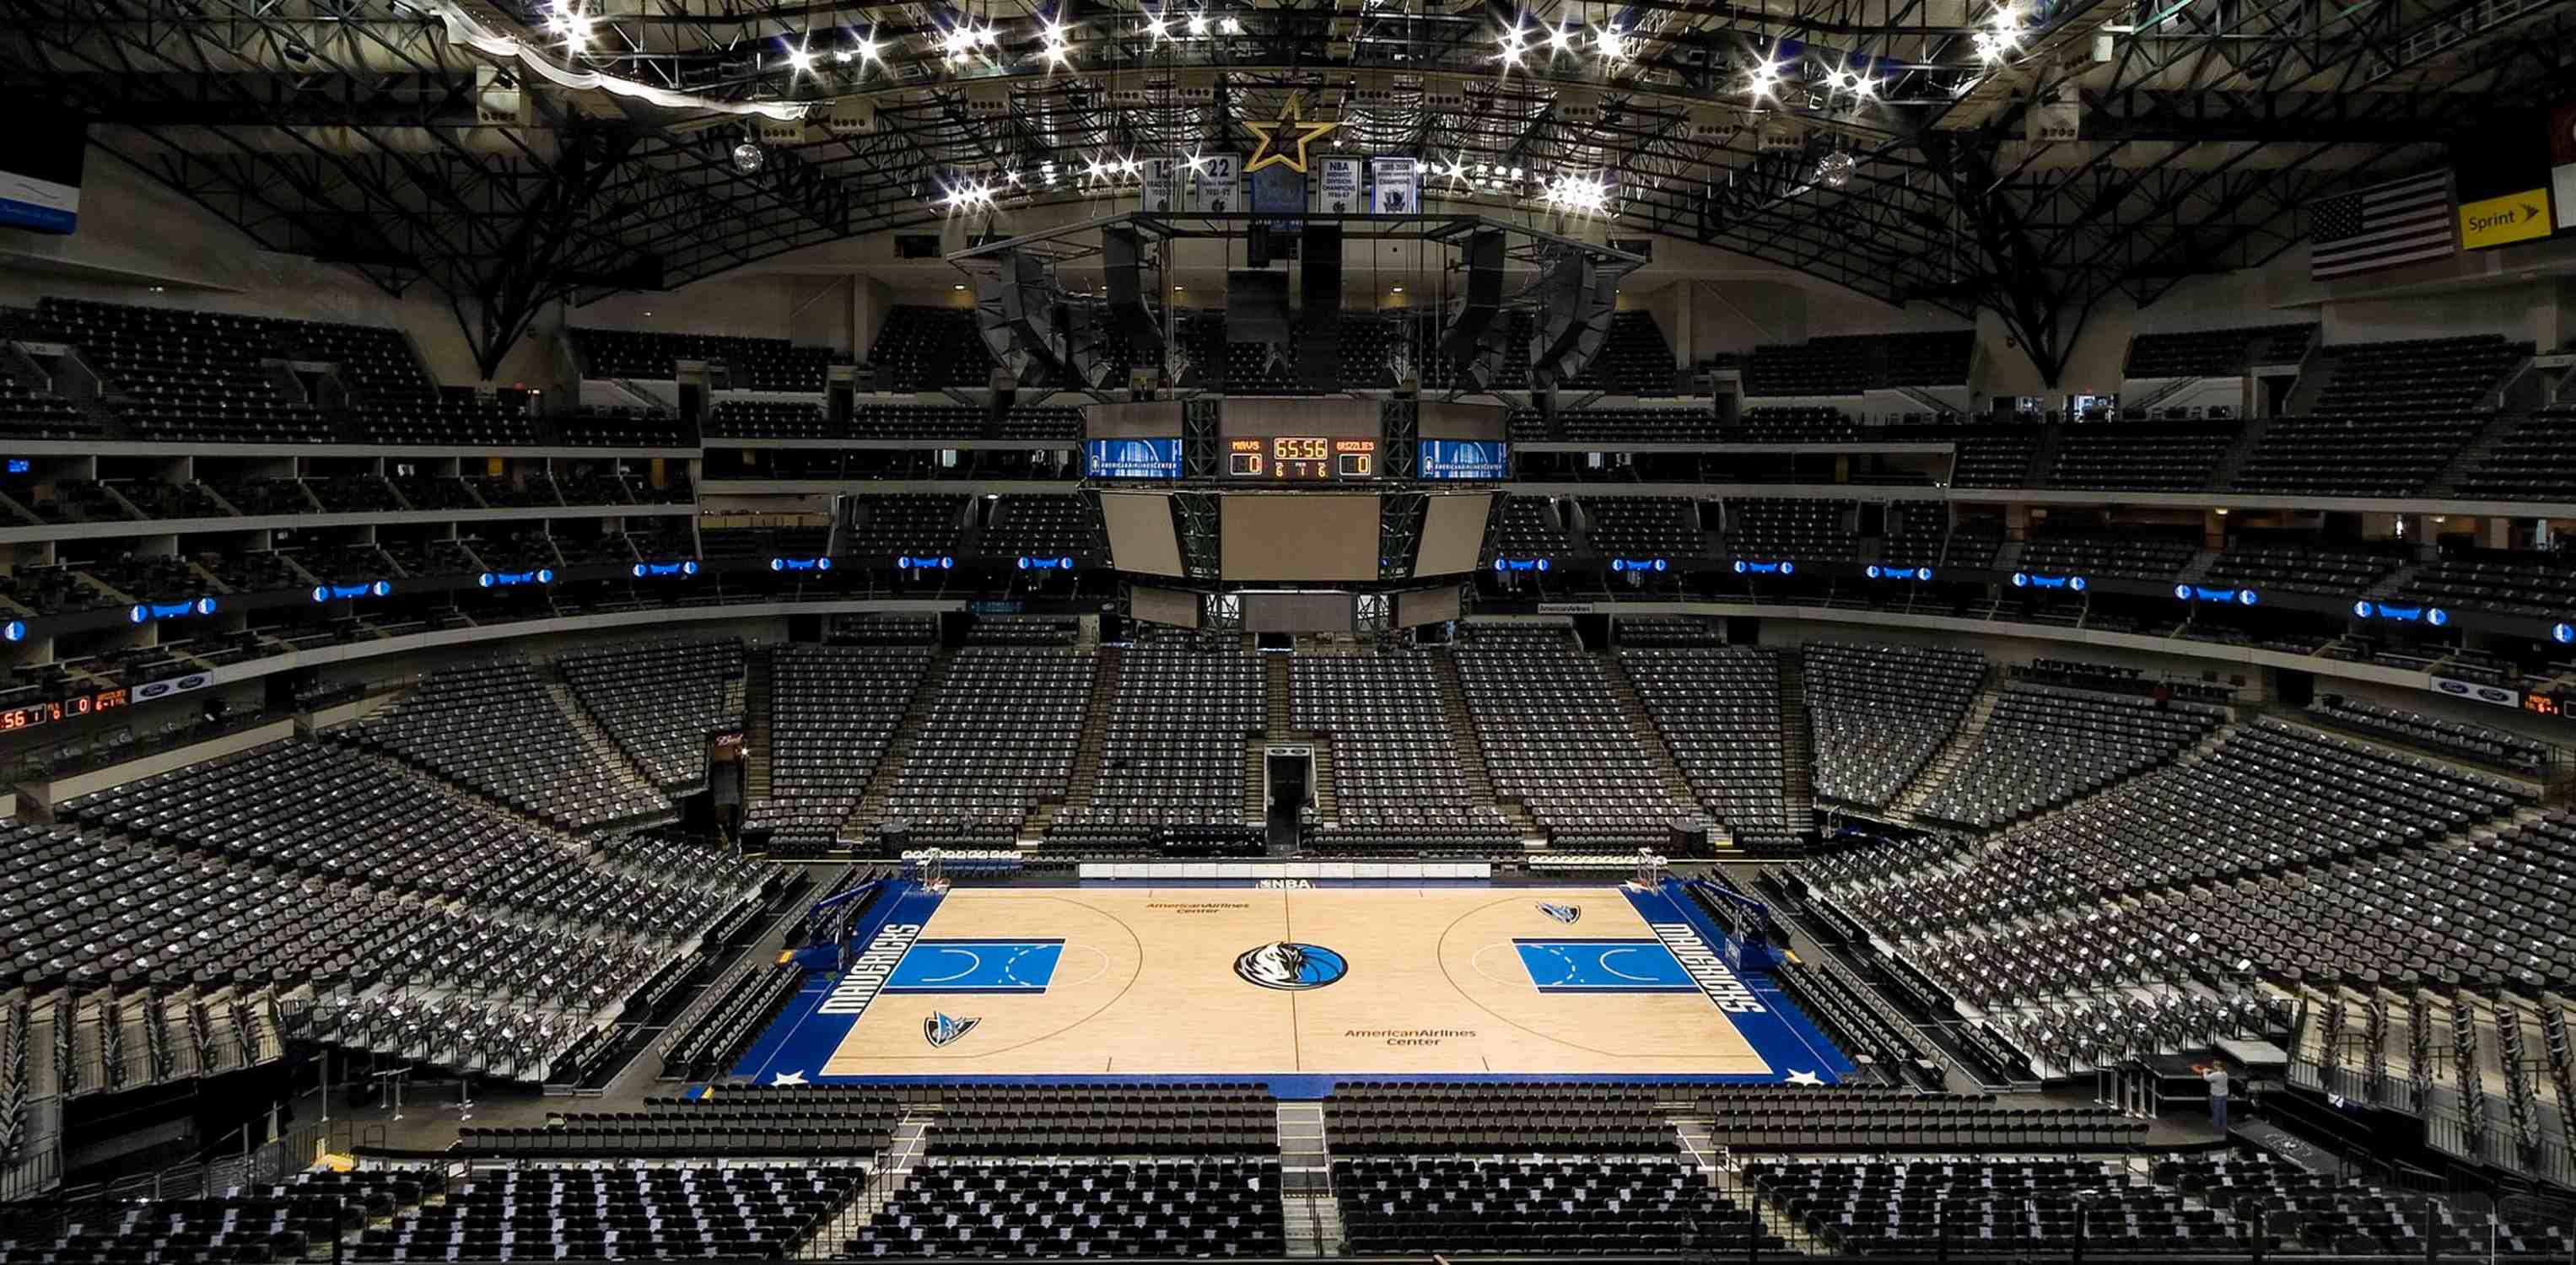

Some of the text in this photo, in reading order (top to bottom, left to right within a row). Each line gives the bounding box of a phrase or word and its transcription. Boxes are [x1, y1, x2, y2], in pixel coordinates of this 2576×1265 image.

[1208, 159, 1229, 176] 22
[1329, 162, 1350, 170] NBA
[2469, 210, 2516, 232] Sprint
[1232, 441, 1259, 450] MAVS
[1276, 440, 1324, 458] 65:56
[1249, 456, 1260, 473] 0
[1276, 466, 1283, 477] 6
[1318, 466, 1325, 477] 6
[1358, 456, 1368, 473] 0
[80, 699, 88, 712] 0
[1272, 879, 1310, 889] NBA
[816, 923, 921, 1014] MAVERICKS
[1651, 923, 1767, 1013] MAVERICKS
